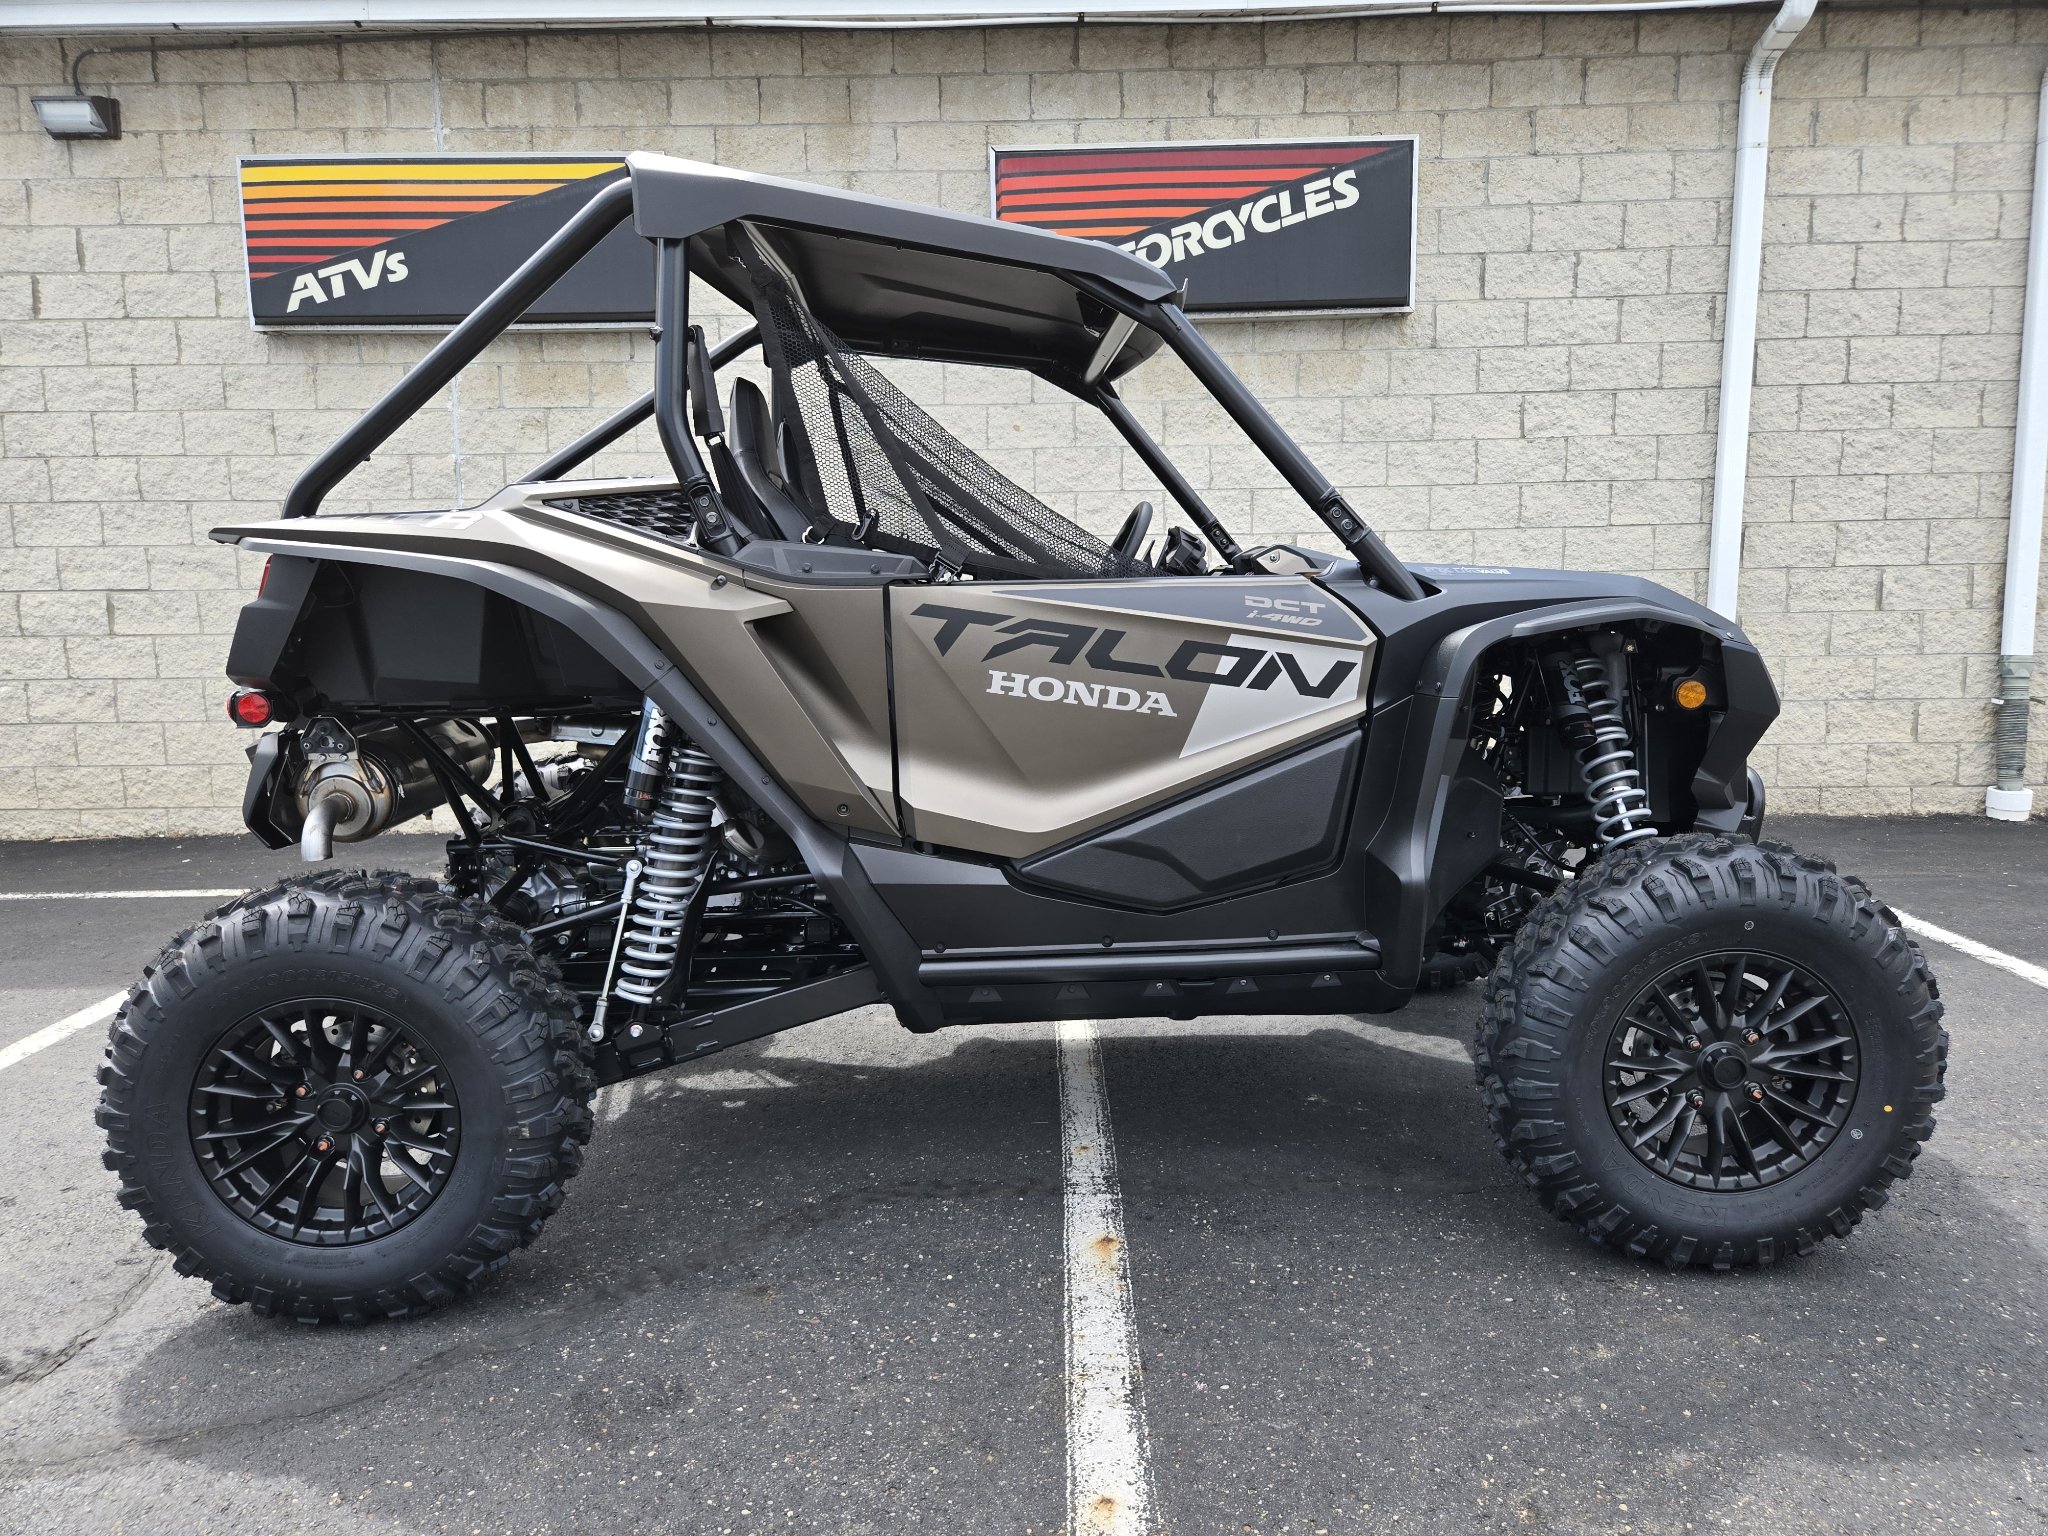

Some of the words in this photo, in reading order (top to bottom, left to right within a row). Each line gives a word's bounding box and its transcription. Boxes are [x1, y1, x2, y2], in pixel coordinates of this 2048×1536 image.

[286, 249, 409, 314] ATVs
[1244, 594, 1326, 614] DCT
[1246, 609, 1323, 627] i-4WD
[910, 602, 1358, 699] TALON
[985, 669, 1178, 718] HONDA
[1559, 660, 1587, 704] FOX
[641, 706, 668, 763] FOX
